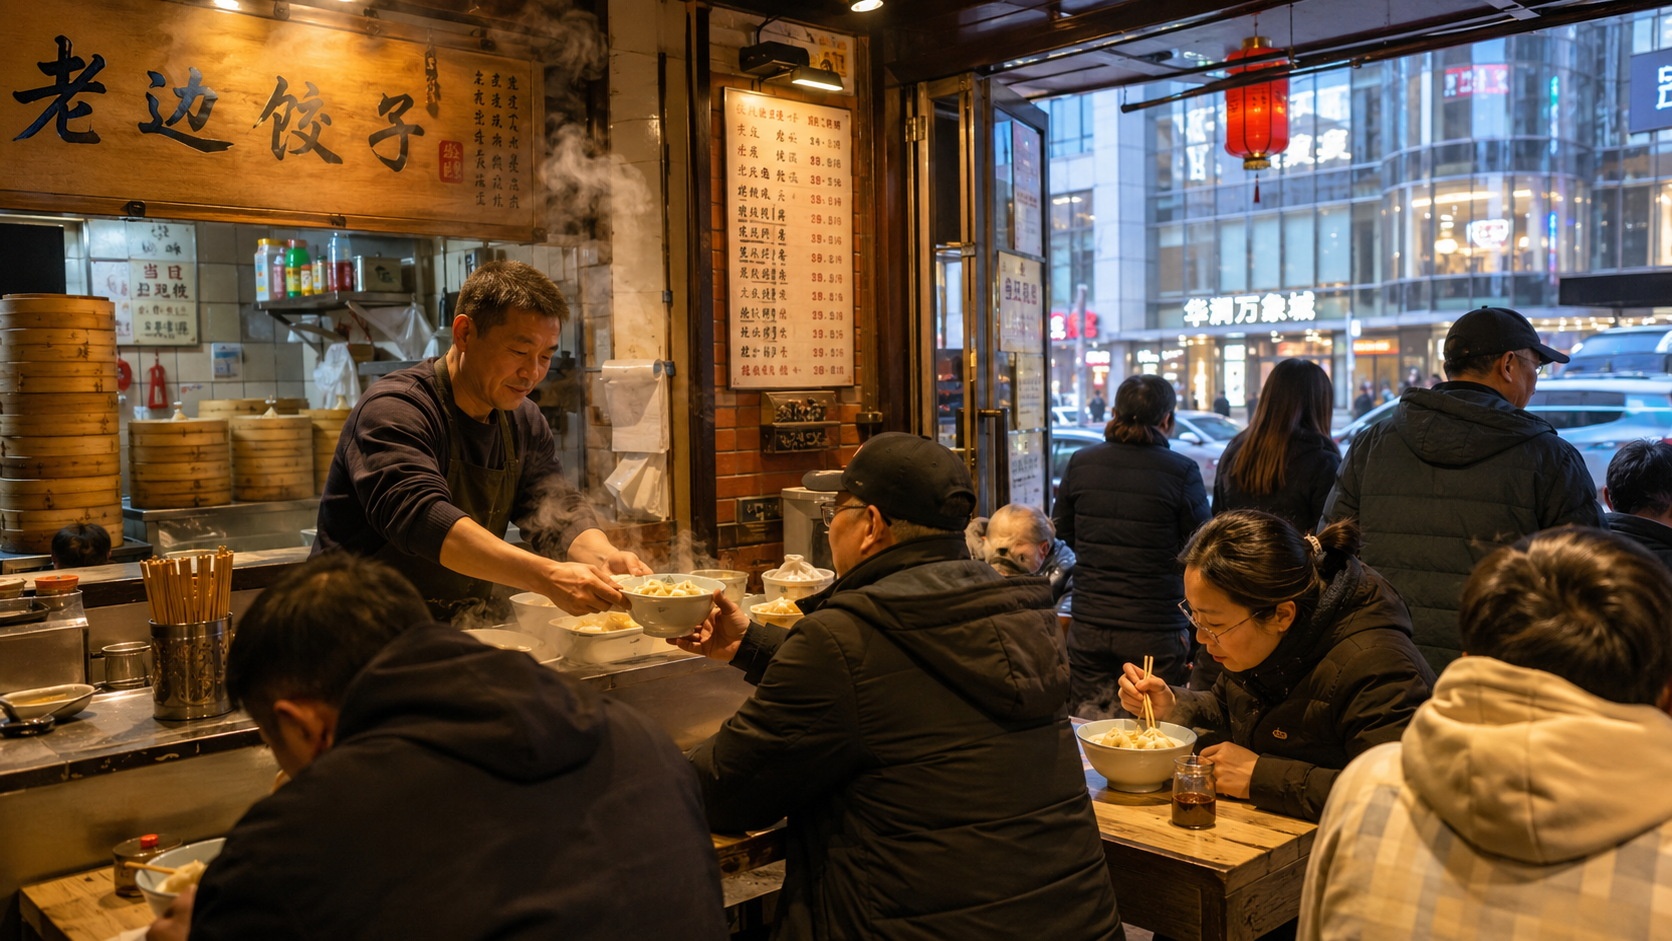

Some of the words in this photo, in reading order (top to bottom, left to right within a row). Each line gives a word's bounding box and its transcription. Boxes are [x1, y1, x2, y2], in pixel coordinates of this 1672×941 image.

[12, 35, 425, 172] 老边饺子
[143, 263, 183, 280] 当日
[1183, 291, 1316, 328] 华润万象城
